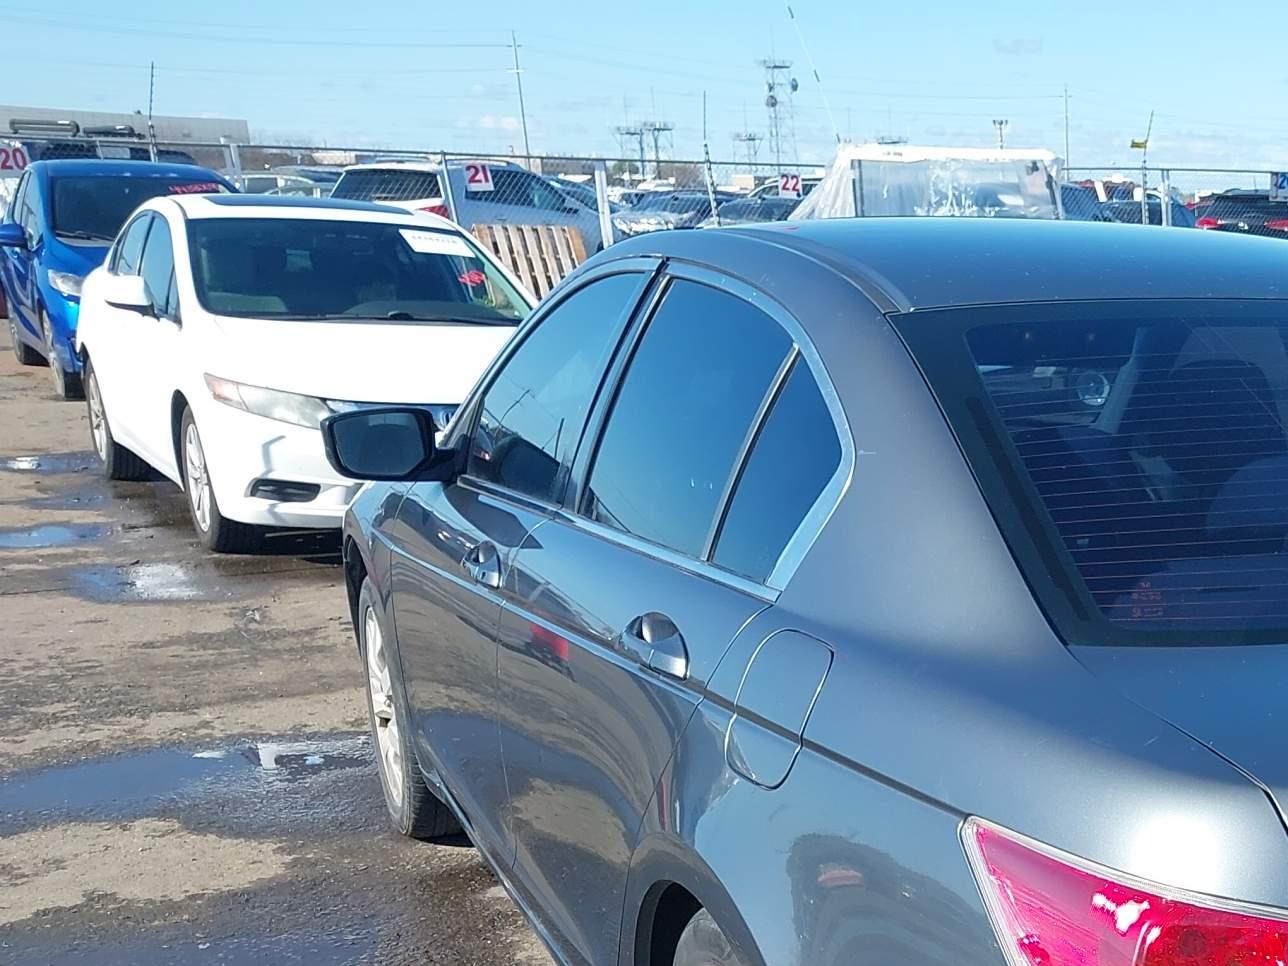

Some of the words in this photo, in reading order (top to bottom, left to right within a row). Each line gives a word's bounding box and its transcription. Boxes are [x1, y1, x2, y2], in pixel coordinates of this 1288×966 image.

[0, 148, 27, 170] 20
[465, 165, 490, 184] 21
[780, 174, 801, 192] 22
